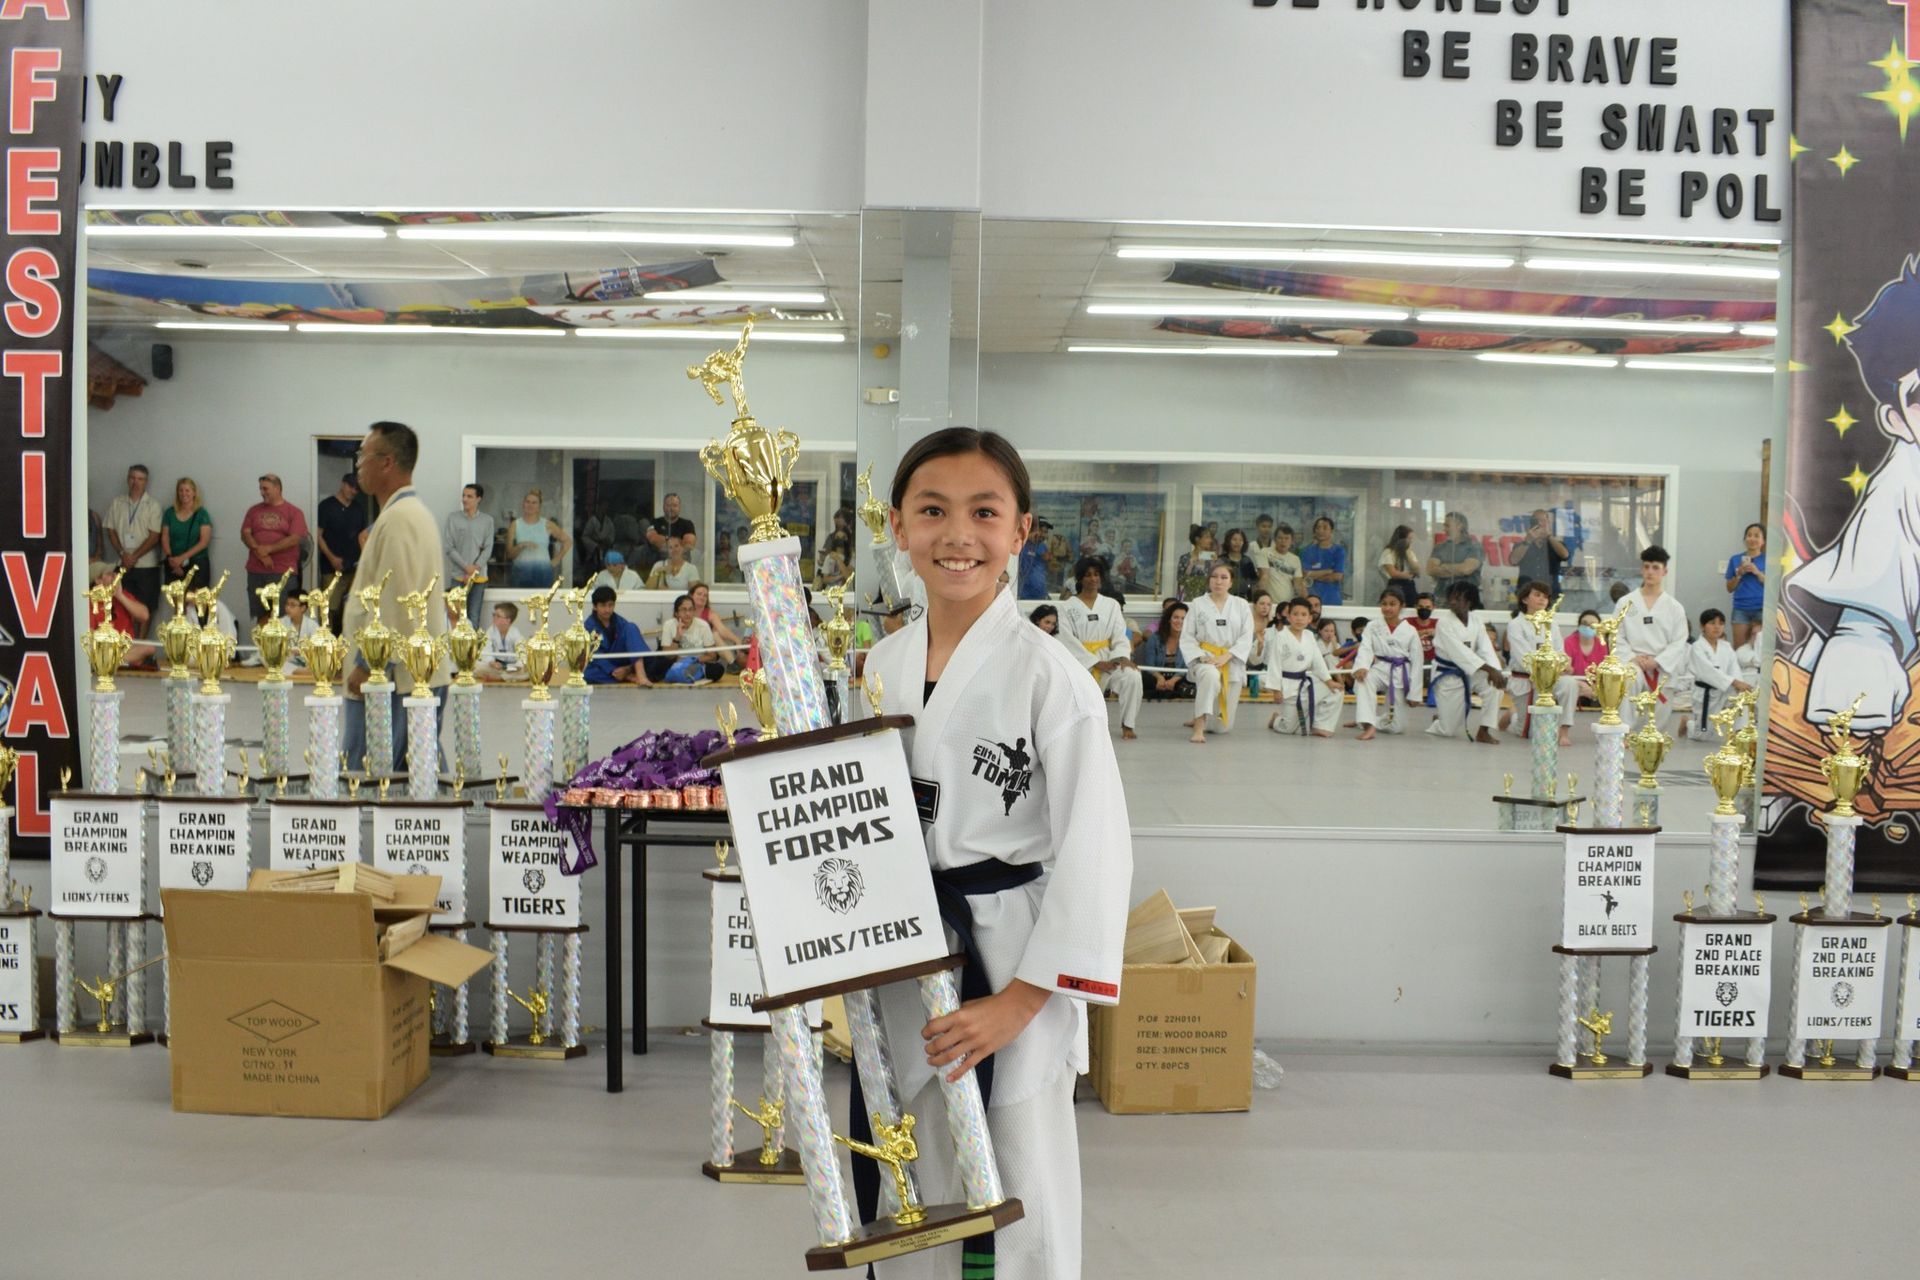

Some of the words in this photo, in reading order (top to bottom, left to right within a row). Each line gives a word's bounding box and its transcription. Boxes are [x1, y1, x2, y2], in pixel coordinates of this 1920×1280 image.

[1403, 29, 1471, 79] BE
[1511, 32, 1678, 85] BRAVE
[1496, 99, 1564, 148] BE
[1600, 102, 1774, 156] SMART
[79, 141, 234, 189] MBLE
[1580, 166, 1646, 216] BE
[1681, 171, 1782, 221] POL
[1, 47, 70, 837] FESTIVAL
[769, 760, 864, 800] GRAND
[971, 755, 1034, 792] TOMA
[757, 786, 889, 833] CHAMPION
[73, 811, 119, 824] GRAND
[178, 812, 226, 826] GRAND
[291, 817, 337, 831] GRAND
[394, 818, 441, 831] GRAND
[63, 827, 128, 839] CHAMPION
[169, 828, 236, 841] CHAMPION
[282, 832, 346, 846] CHAMPION
[386, 833, 450, 846] CHAMPION
[765, 816, 894, 865] FORMS
[64, 841, 128, 854] BREAKING
[170, 843, 235, 856] BREAKING
[1588, 845, 1633, 858] GRAND
[283, 847, 345, 862] WEAPONS
[387, 849, 450, 862] WEAPONS
[502, 851, 559, 865] WEAPON
[1578, 860, 1642, 872] CHAMPION
[1578, 875, 1641, 887] BREAKING
[62, 891, 130, 904] LIONS/TEENS
[502, 897, 566, 915] TIGERS
[1578, 924, 1608, 936] BLACK
[1611, 924, 1638, 936] BELTS
[784, 916, 923, 965] LIONS/TEENS
[1705, 933, 1752, 947] GRAND
[1821, 936, 1867, 949] GRAND
[1695, 949, 1719, 961] 2ND
[1725, 949, 1762, 962] PLACE
[1812, 952, 1836, 964] 2ND
[1841, 952, 1876, 964] PLACE
[1695, 964, 1760, 977] BREAKING
[1812, 966, 1875, 978] BREAKING
[247, 1017, 267, 1026] TOP
[269, 1018, 303, 1028] WOOD
[1693, 1010, 1756, 1027] TIGERS
[1807, 1016, 1873, 1028] LIONS/TEENS
[1164, 1031, 1193, 1039] WOOD
[1195, 1031, 1228, 1039] BOARD
[242, 1047, 266, 1057] NEW
[268, 1047, 297, 1058] YORK
[1200, 1046, 1228, 1054] THICK
[243, 1072, 272, 1083] MADE
[275, 1074, 285, 1083] IN
[287, 1074, 321, 1084] CHINA
